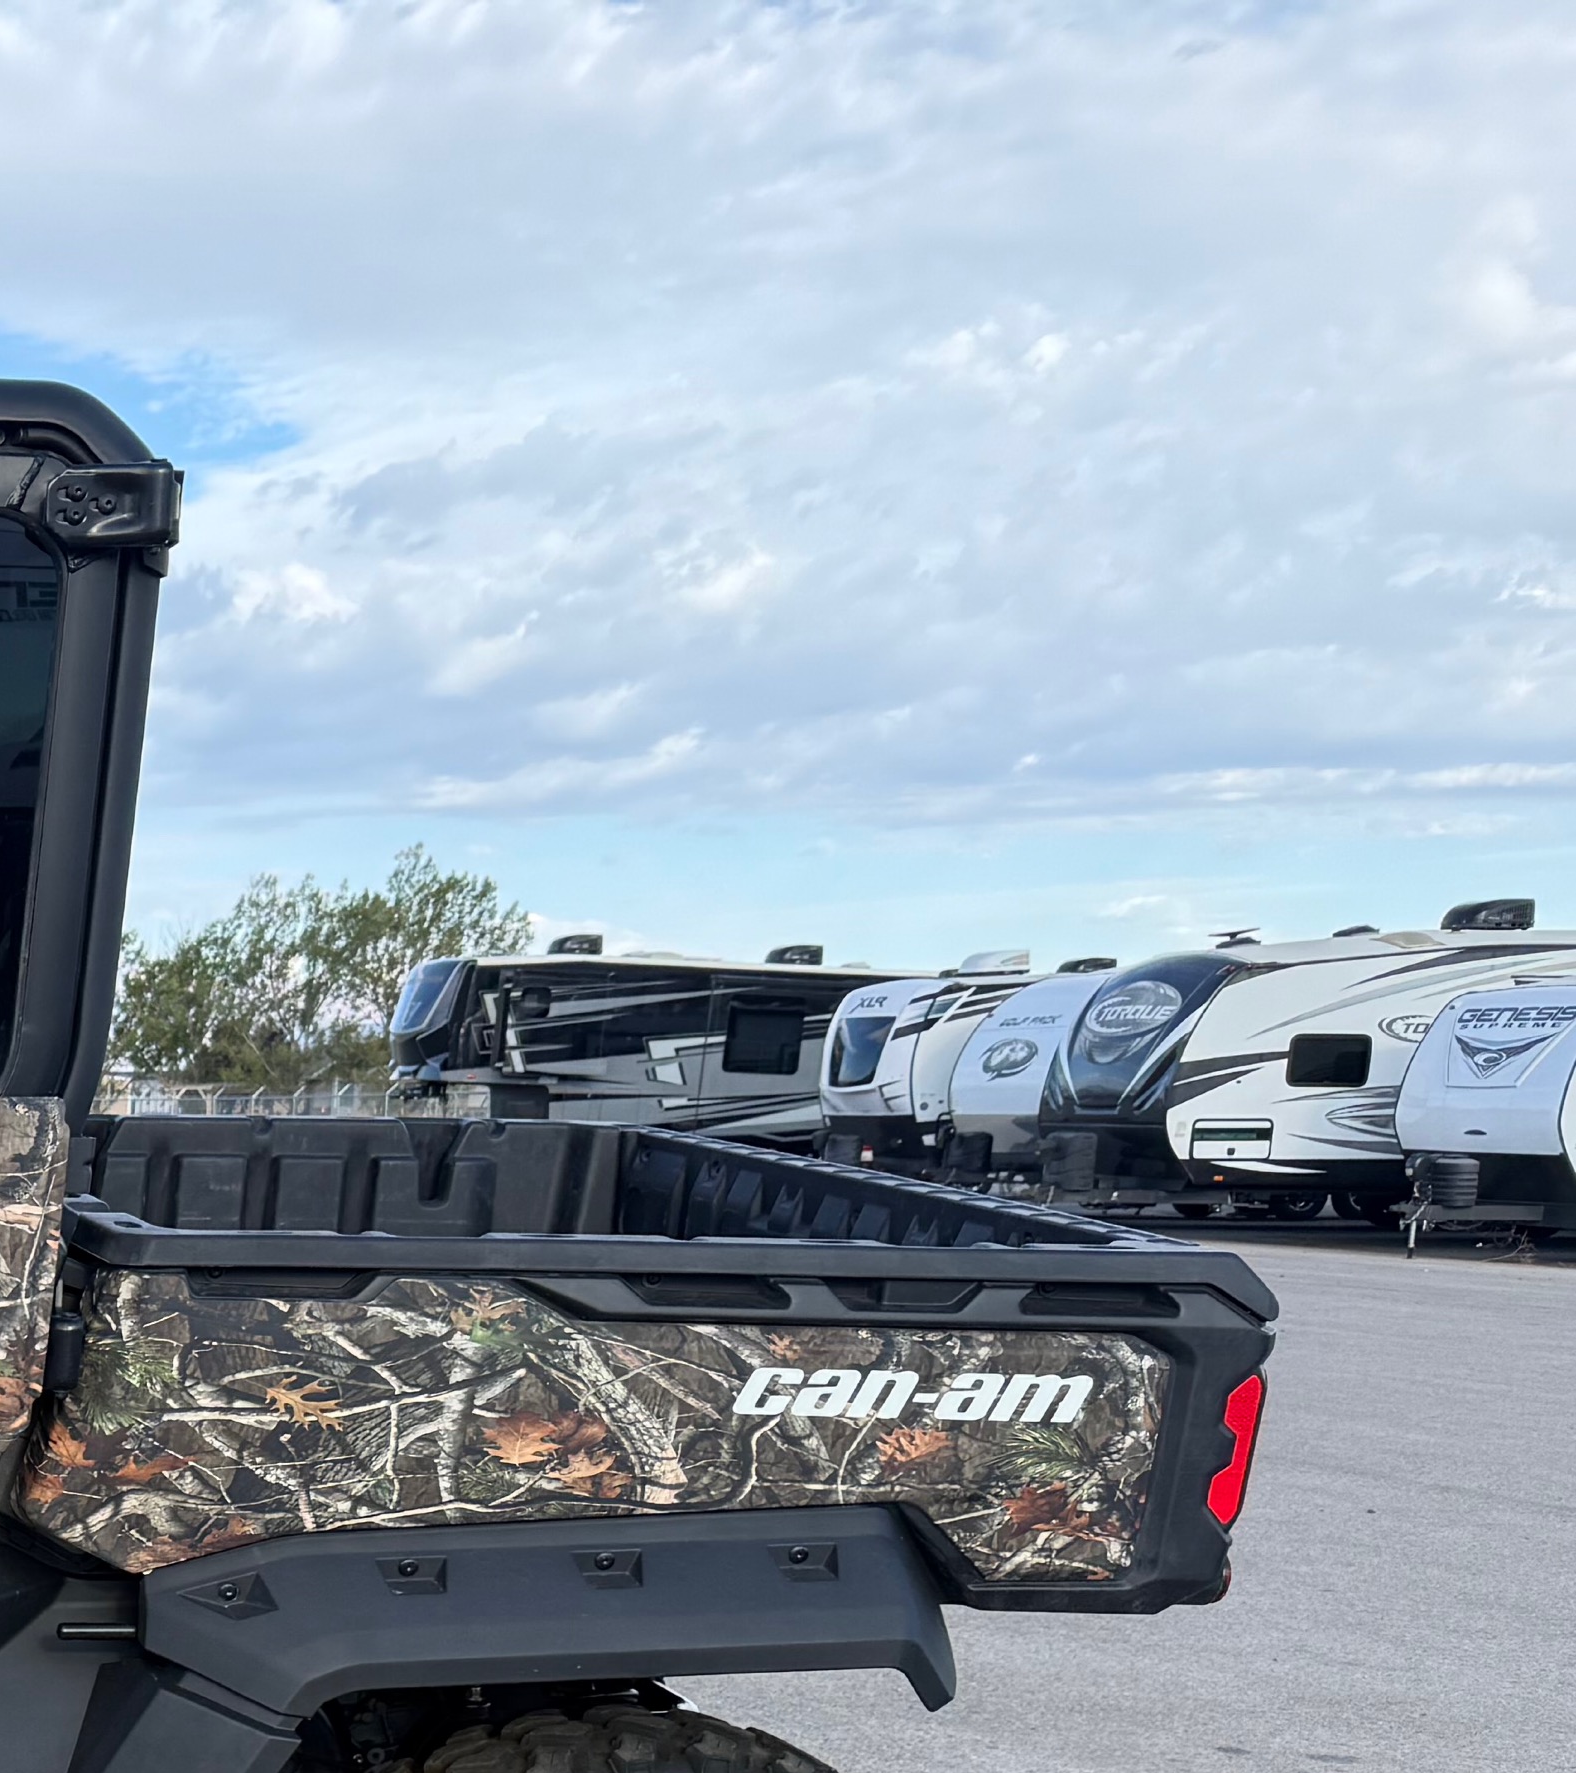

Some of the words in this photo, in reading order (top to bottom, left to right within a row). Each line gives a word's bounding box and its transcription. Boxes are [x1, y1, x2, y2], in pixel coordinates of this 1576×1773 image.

[1098, 1004, 1178, 1021] TORQUE
[1457, 1006, 1576, 1024] GENESIS
[1459, 1021, 1564, 1031] SUPREME
[732, 1367, 1094, 1423] can-am
